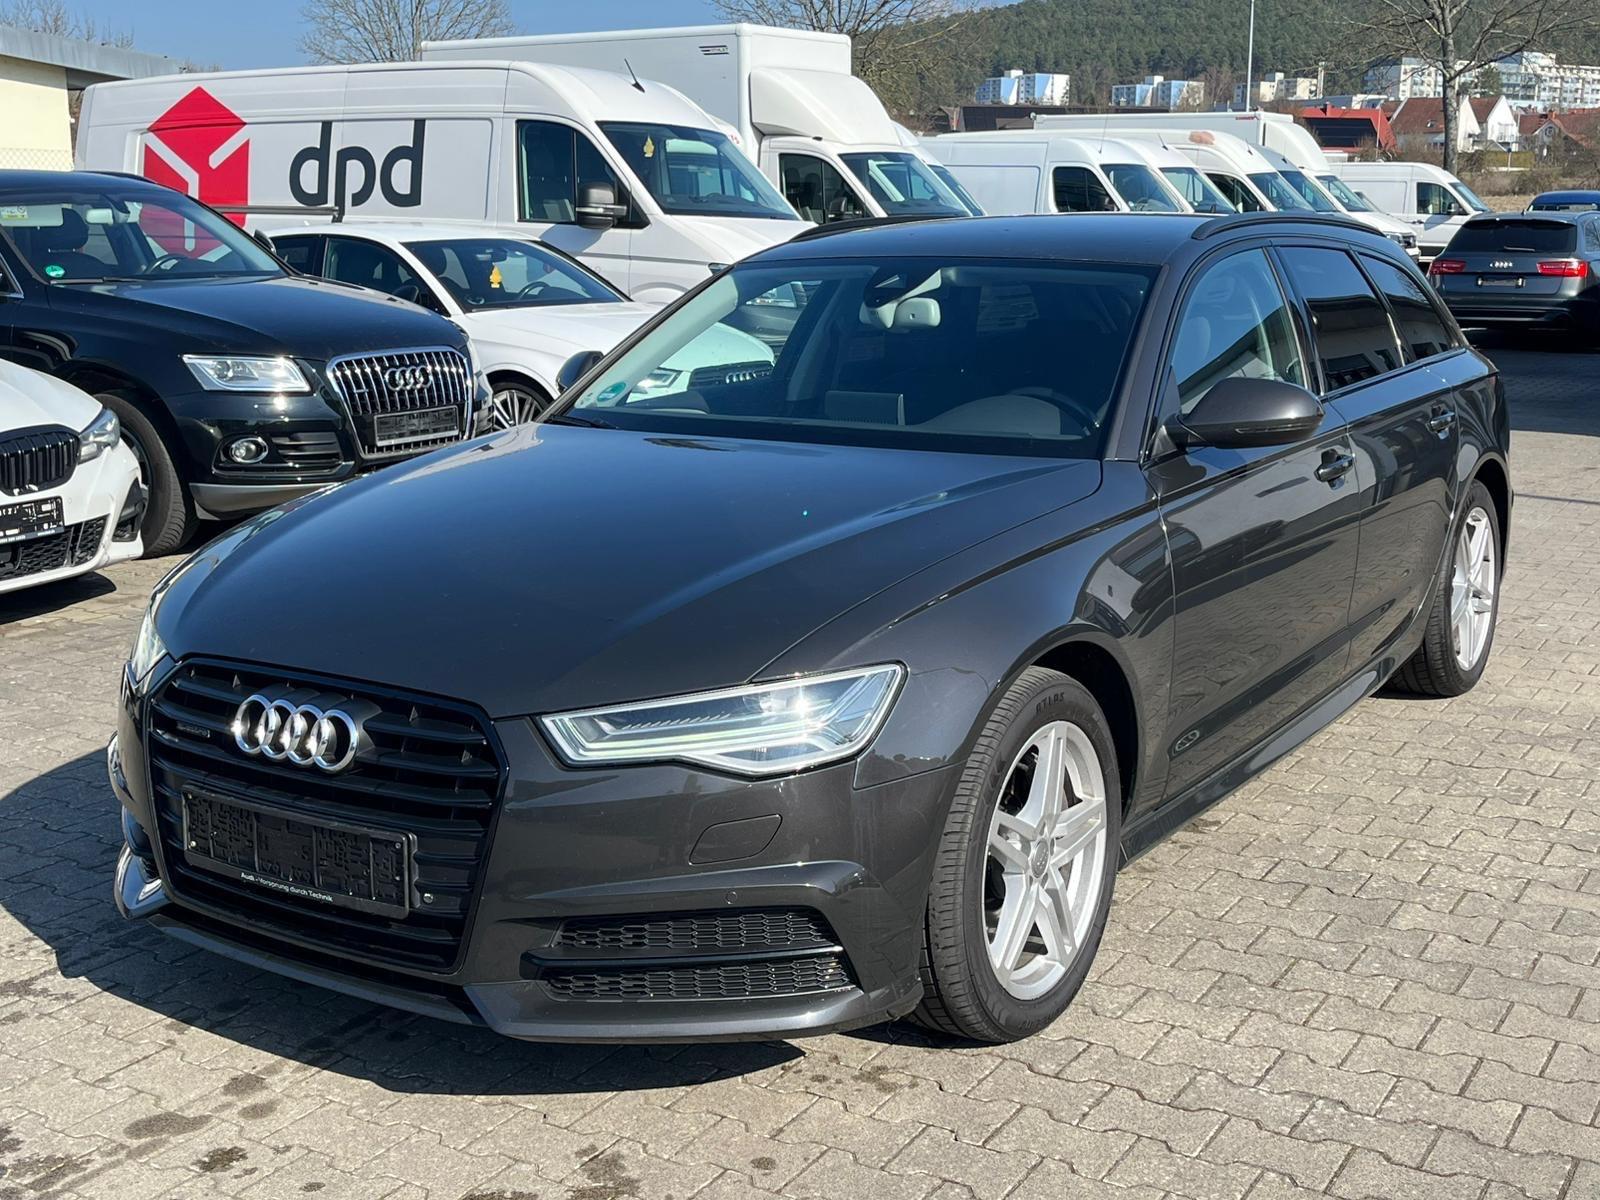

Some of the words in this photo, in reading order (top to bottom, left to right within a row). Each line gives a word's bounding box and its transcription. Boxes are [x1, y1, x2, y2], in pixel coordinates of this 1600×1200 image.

[290, 119, 426, 222] dpd
[289, 885, 308, 896] durch
[308, 889, 333, 902] Technik
